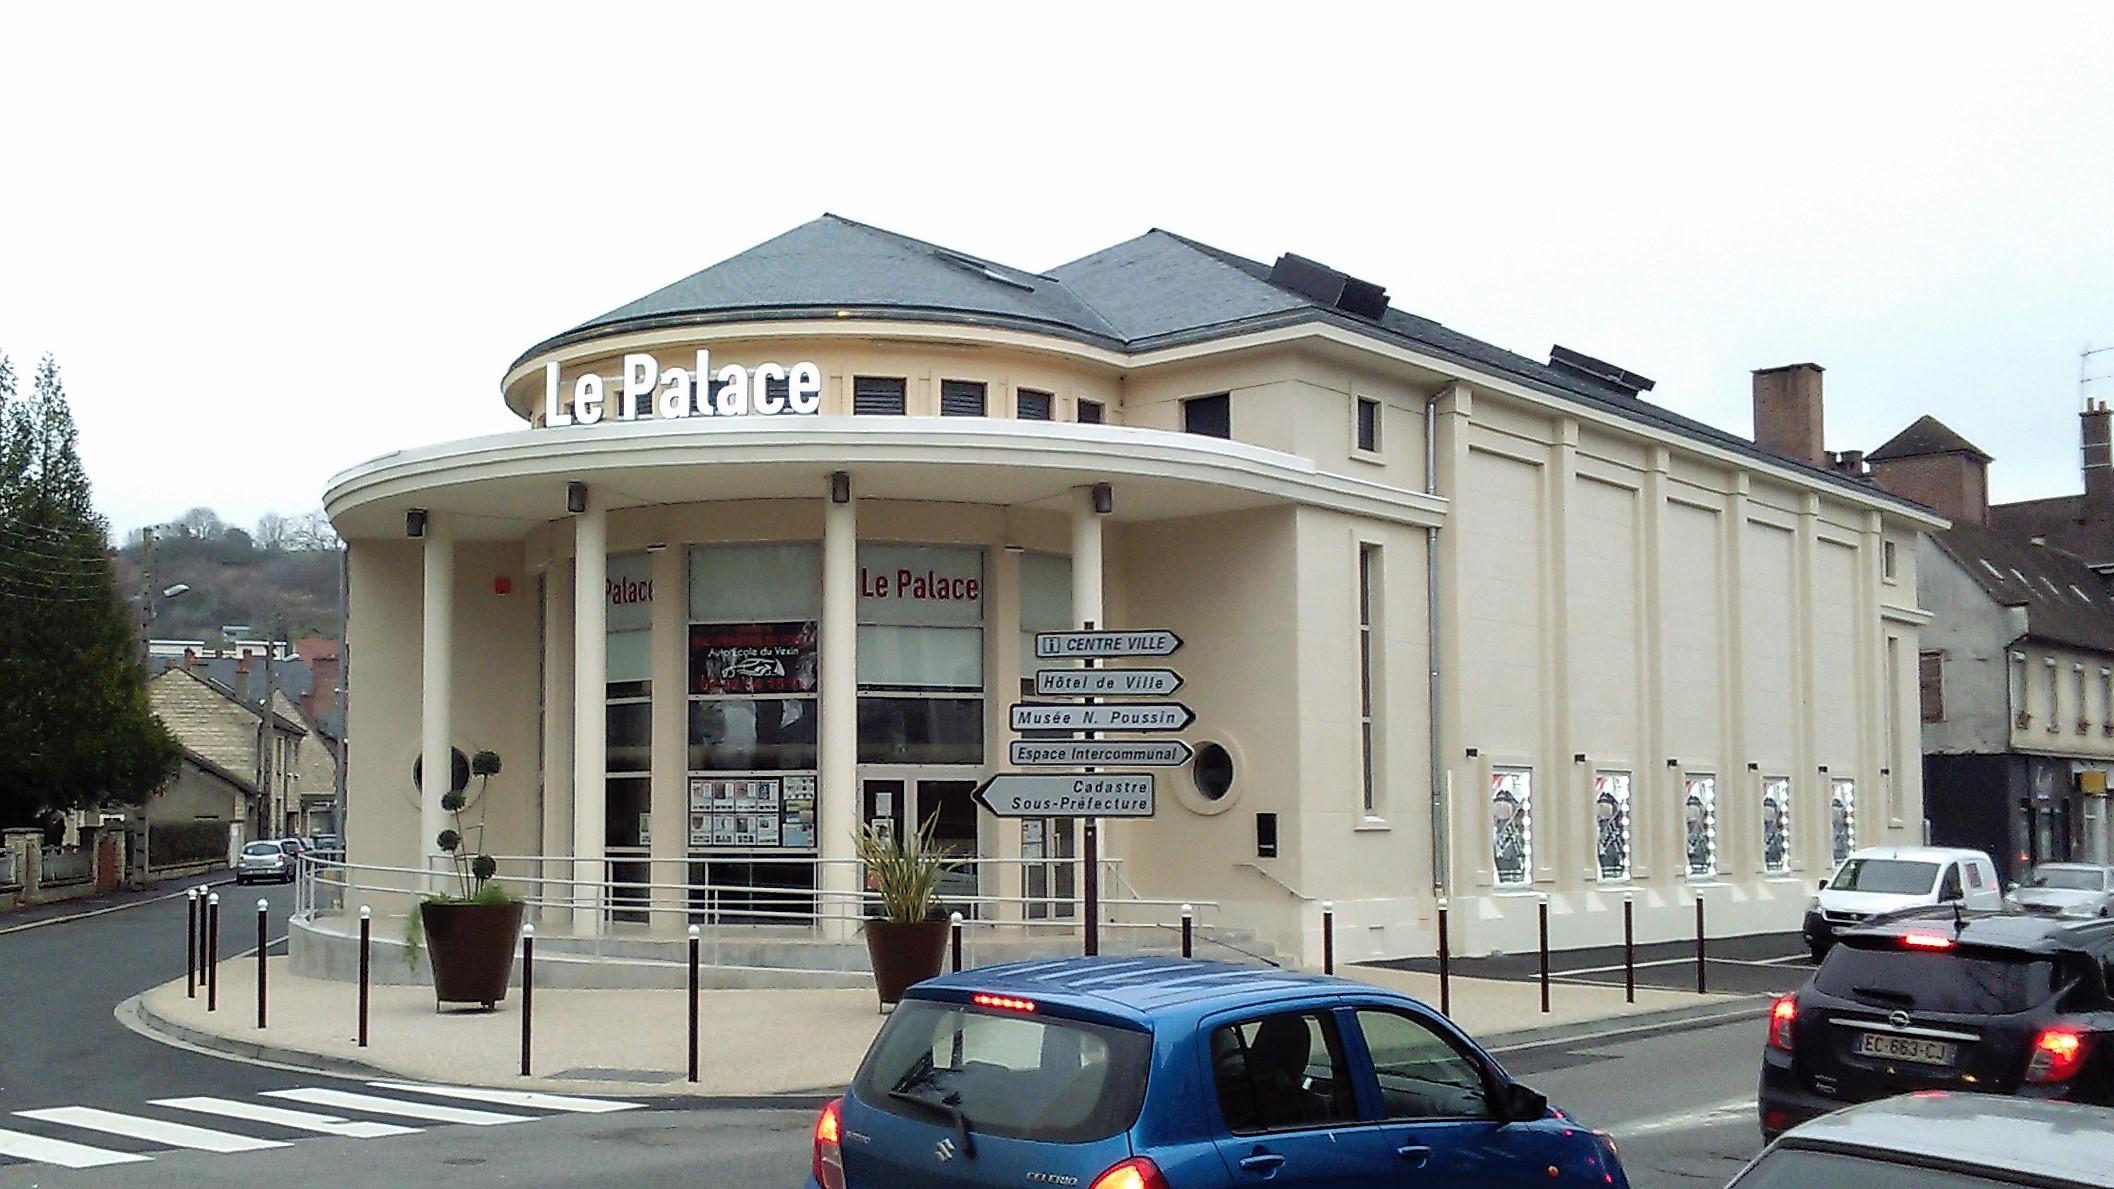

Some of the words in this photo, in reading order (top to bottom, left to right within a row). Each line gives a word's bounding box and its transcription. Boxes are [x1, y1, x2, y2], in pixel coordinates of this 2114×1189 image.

[546, 361, 604, 428] Le
[624, 349, 821, 421] Palace
[862, 568, 889, 598] Le
[897, 569, 979, 600] Palace
[1066, 637, 1122, 651] CENTRE
[1127, 636, 1167, 650] VILLE
[1043, 675, 1088, 689] Hôtel
[1096, 676, 1115, 689] de
[1126, 675, 1164, 689] Ville
[1017, 711, 1071, 725] Musée
[1082, 711, 1098, 725] N.
[1110, 710, 1176, 724] Poussin
[1017, 747, 1066, 763] Espace
[1071, 746, 1177, 760] Intercommunal
[1072, 780, 1148, 794] Cadastre
[1011, 796, 1148, 811] Sous-Préfecture
